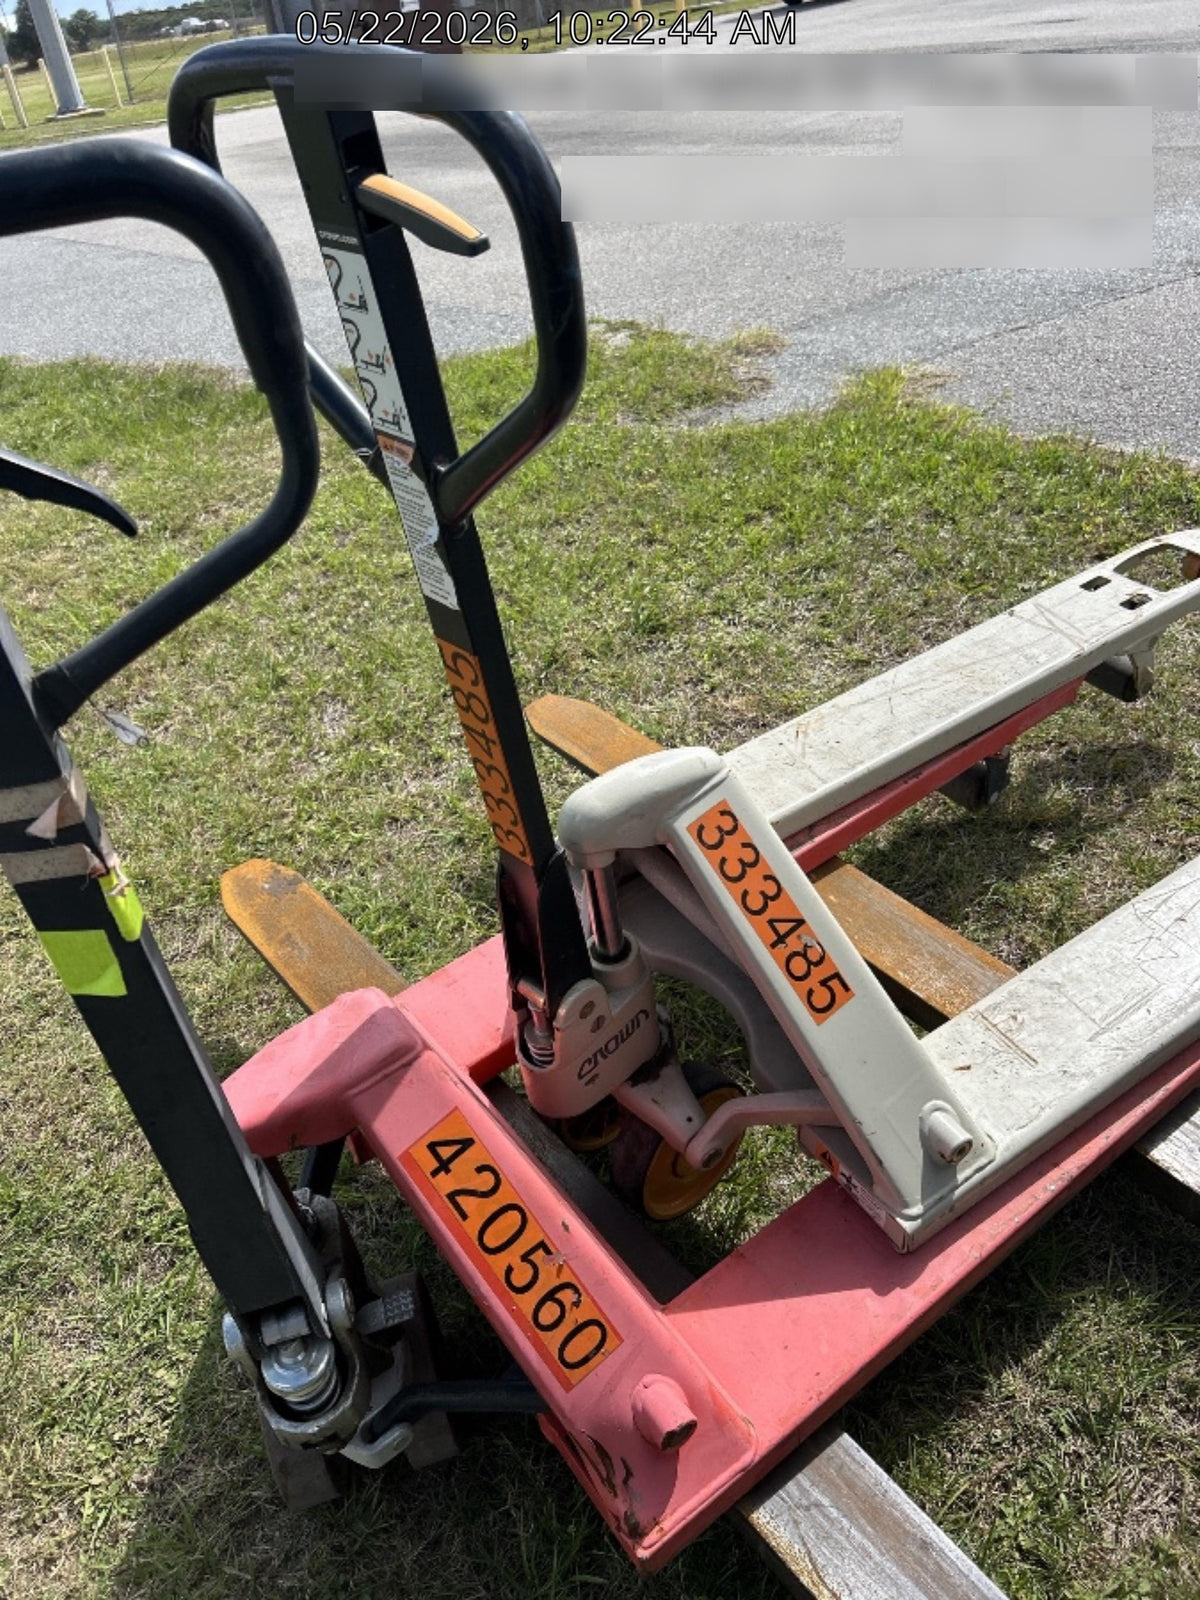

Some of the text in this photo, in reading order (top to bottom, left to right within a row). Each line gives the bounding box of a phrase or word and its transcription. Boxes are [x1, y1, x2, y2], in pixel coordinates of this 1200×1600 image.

[444, 650, 527, 857] 333485
[697, 809, 851, 1014] 333485
[426, 1136, 607, 1370] 420560
